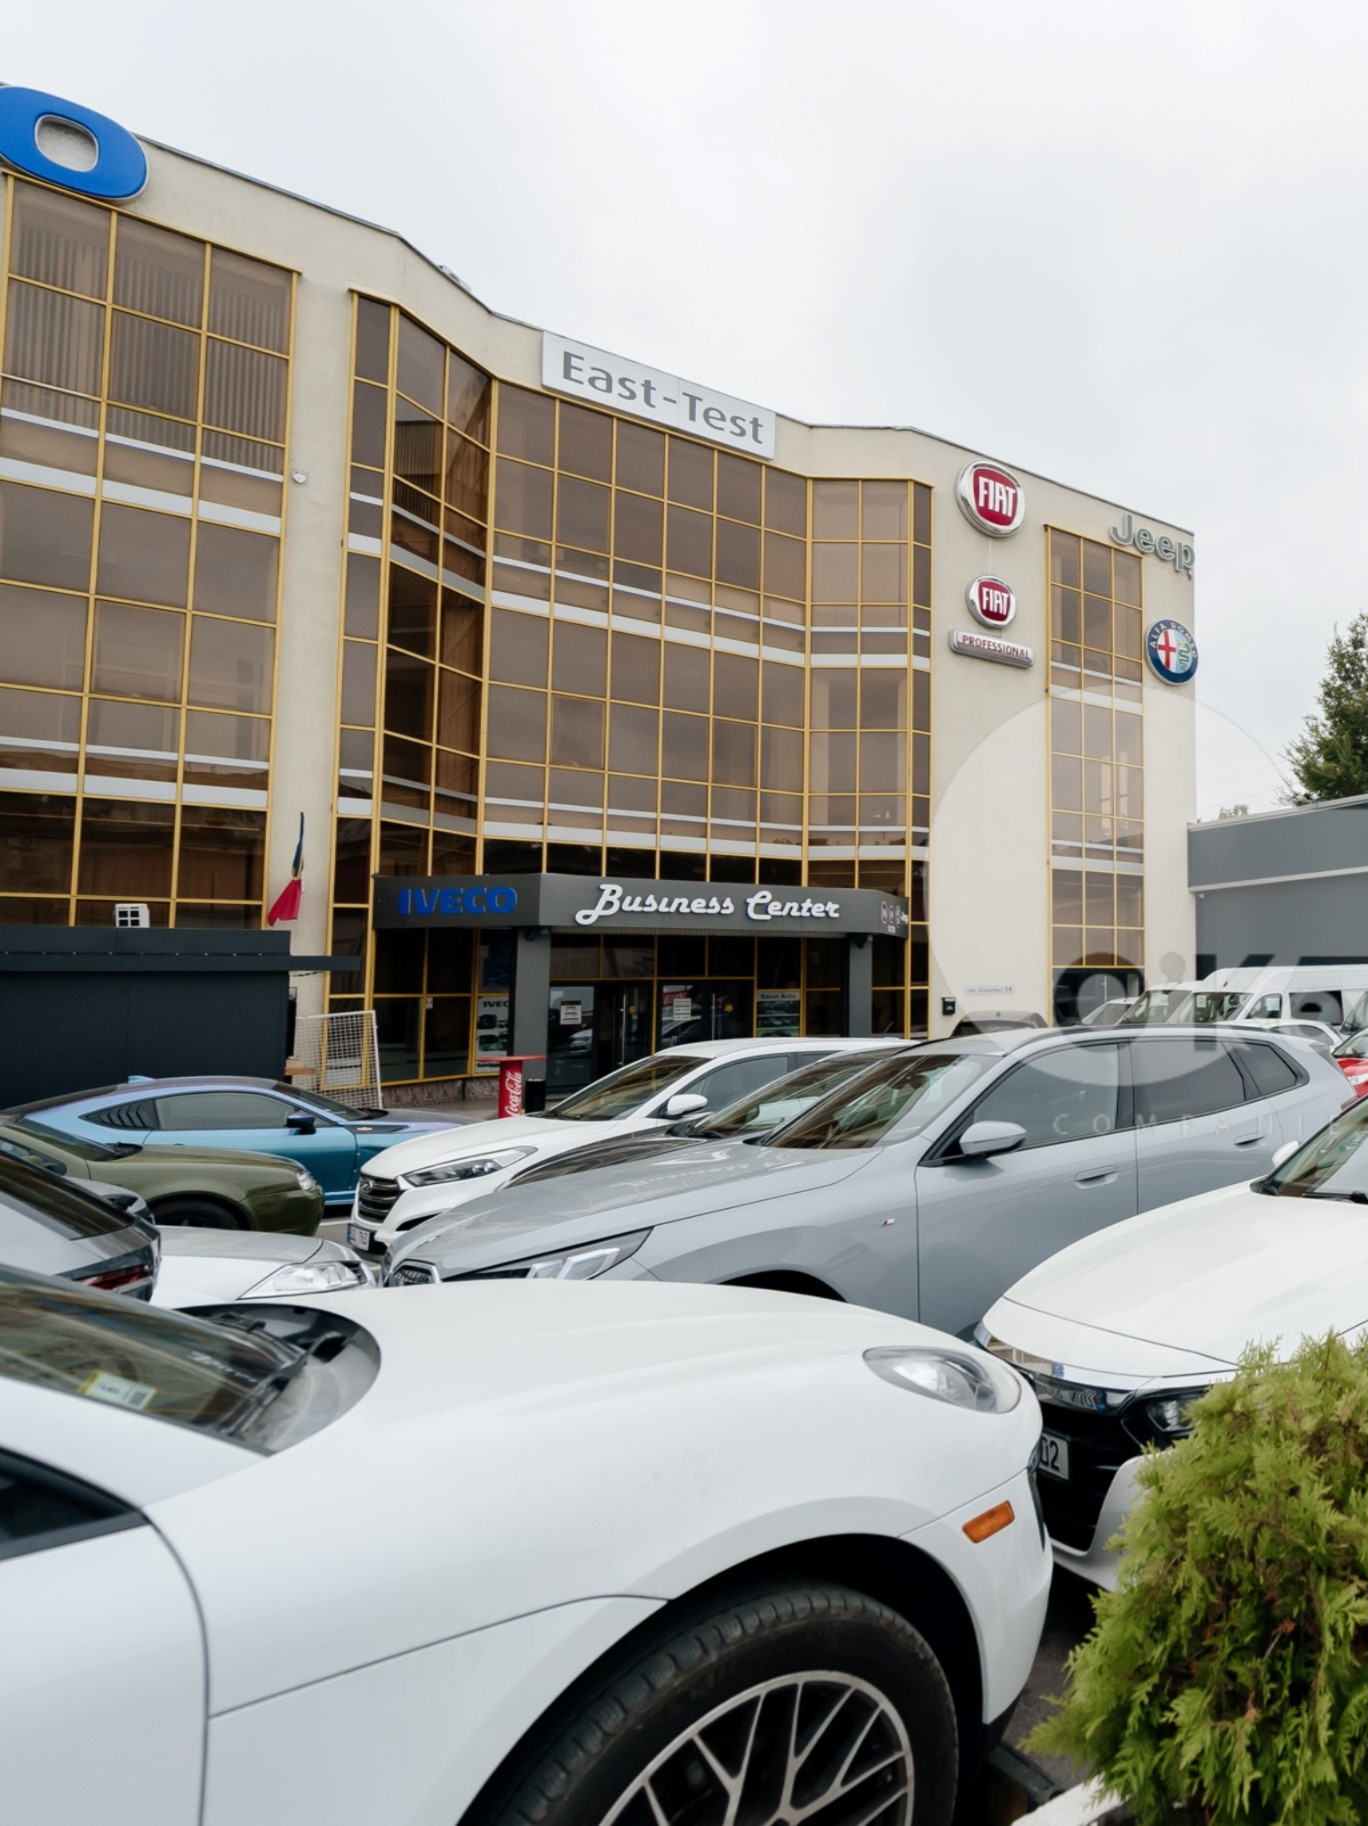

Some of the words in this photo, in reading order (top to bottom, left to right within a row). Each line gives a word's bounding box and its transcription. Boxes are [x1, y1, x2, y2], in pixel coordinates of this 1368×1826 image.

[563, 350, 764, 445] East-Test
[978, 475, 1016, 518] FIAT
[1109, 513, 1196, 573] Jeep
[981, 586, 1010, 616] FIAT
[962, 633, 1031, 660] PROFESSIONAL
[1149, 621, 1168, 649] ALFA
[1169, 621, 1199, 659] ROMEO
[398, 886, 518, 916] IVECO
[575, 883, 735, 925] Business
[746, 890, 840, 920] Center
